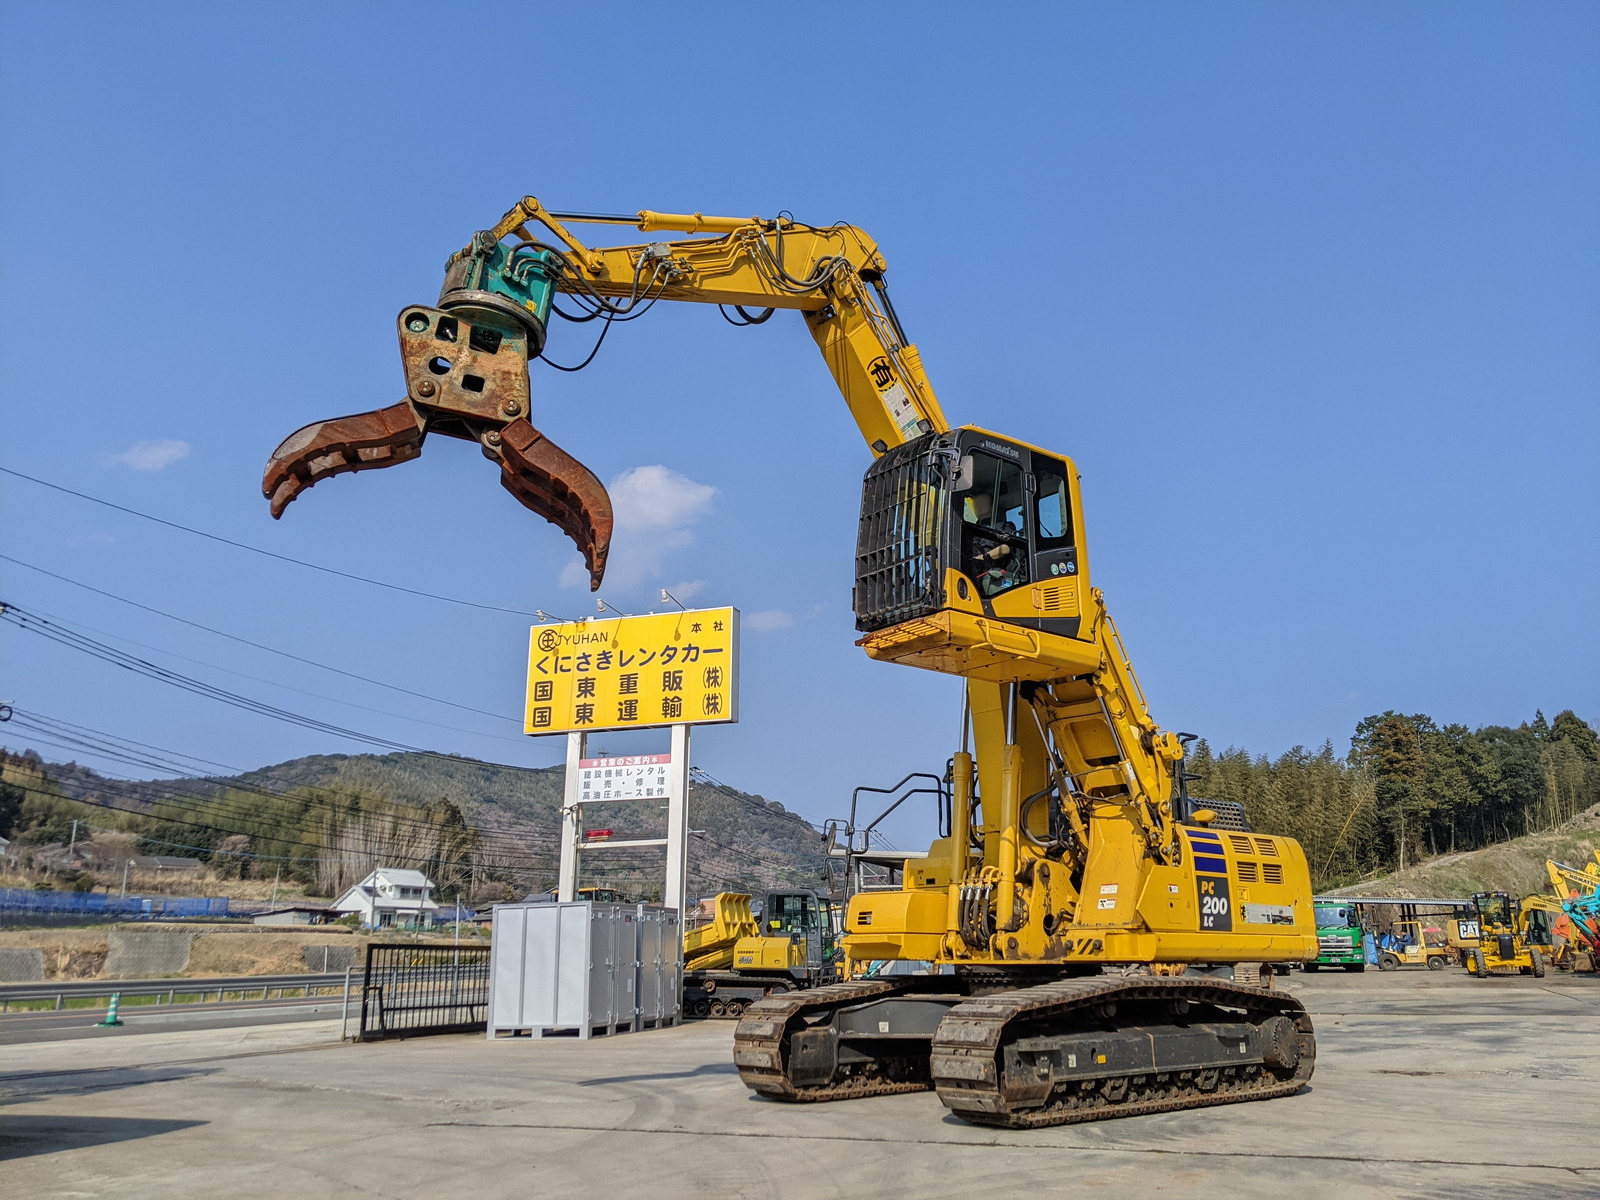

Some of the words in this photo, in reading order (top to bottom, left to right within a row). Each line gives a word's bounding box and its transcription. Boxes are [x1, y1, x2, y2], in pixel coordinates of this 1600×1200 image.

[691, 620, 723, 634] 本社
[536, 643, 723, 674] くにさきレンタカー
[583, 766, 665, 779] 建設機械レンタル
[1201, 881, 1215, 895] PC
[1202, 896, 1228, 915] 200
[1203, 916, 1214, 927] LC
[1460, 924, 1480, 938] CAT
